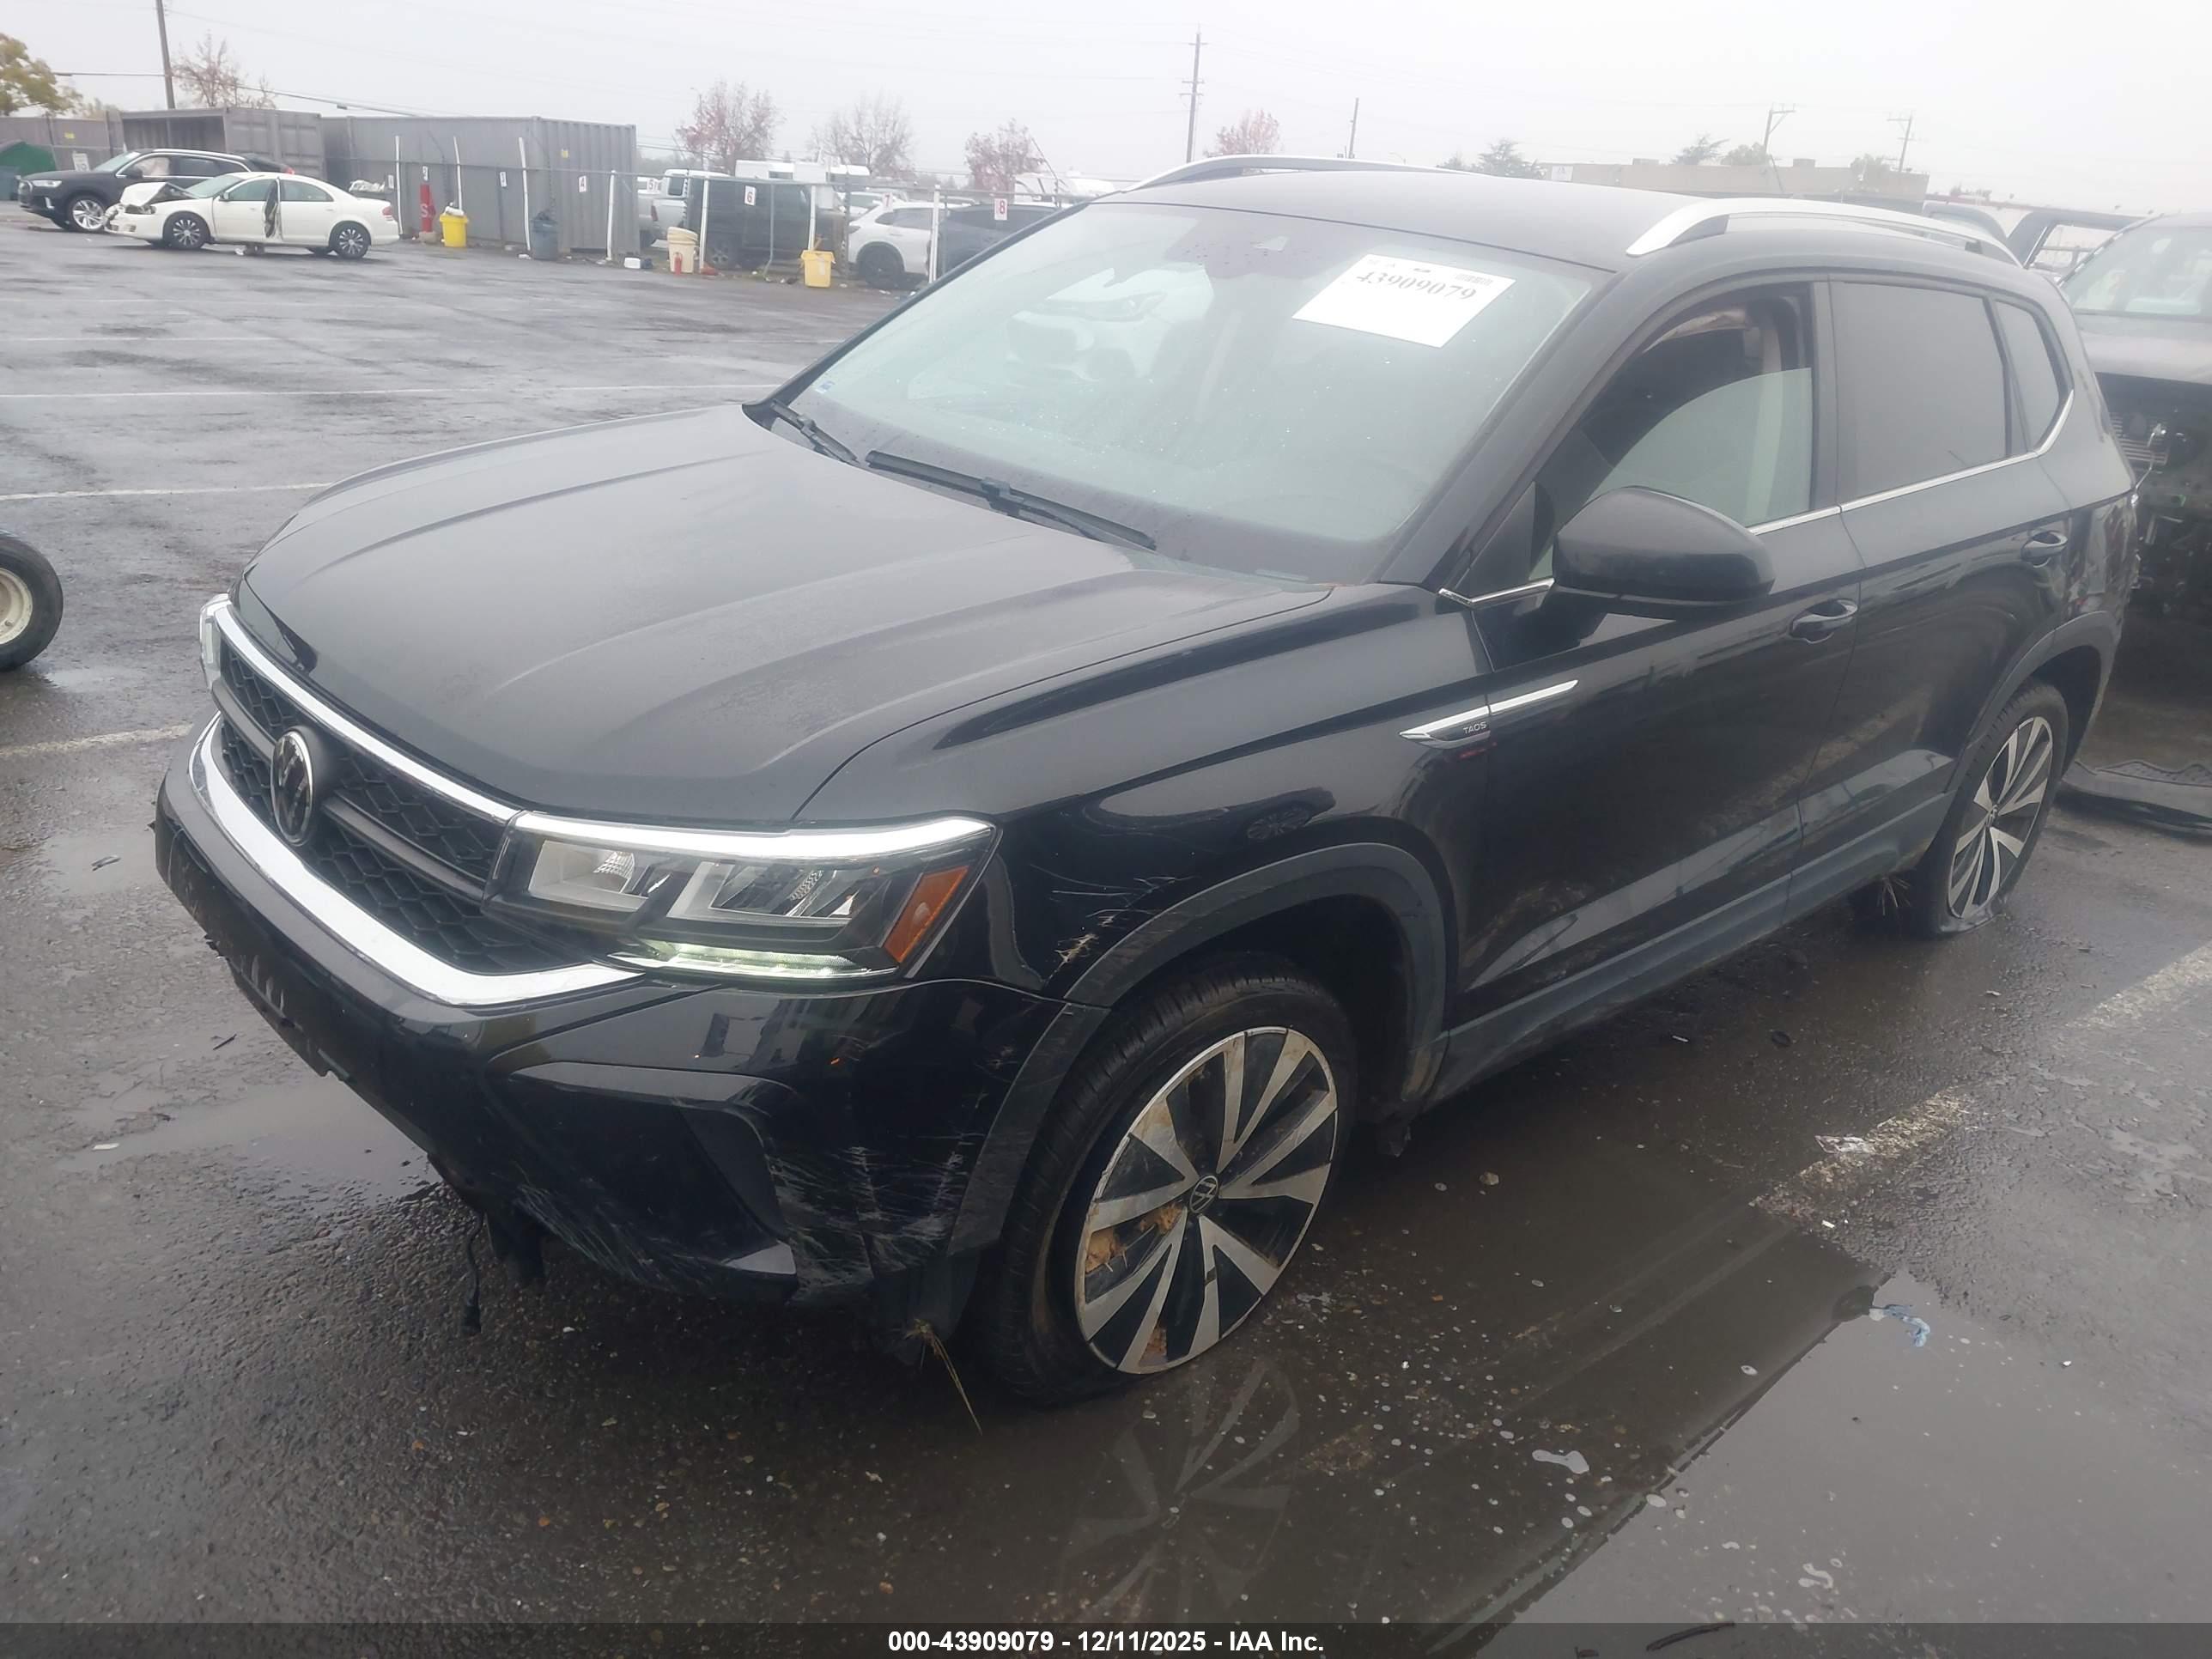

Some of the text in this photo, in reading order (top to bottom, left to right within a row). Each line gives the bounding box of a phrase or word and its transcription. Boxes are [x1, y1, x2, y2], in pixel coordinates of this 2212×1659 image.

[746, 191, 753, 204] 6
[884, 193, 890, 207] 7
[999, 200, 1006, 215] 8
[1356, 270, 1477, 300] 43909079
[1463, 721, 1487, 734] TAOS
